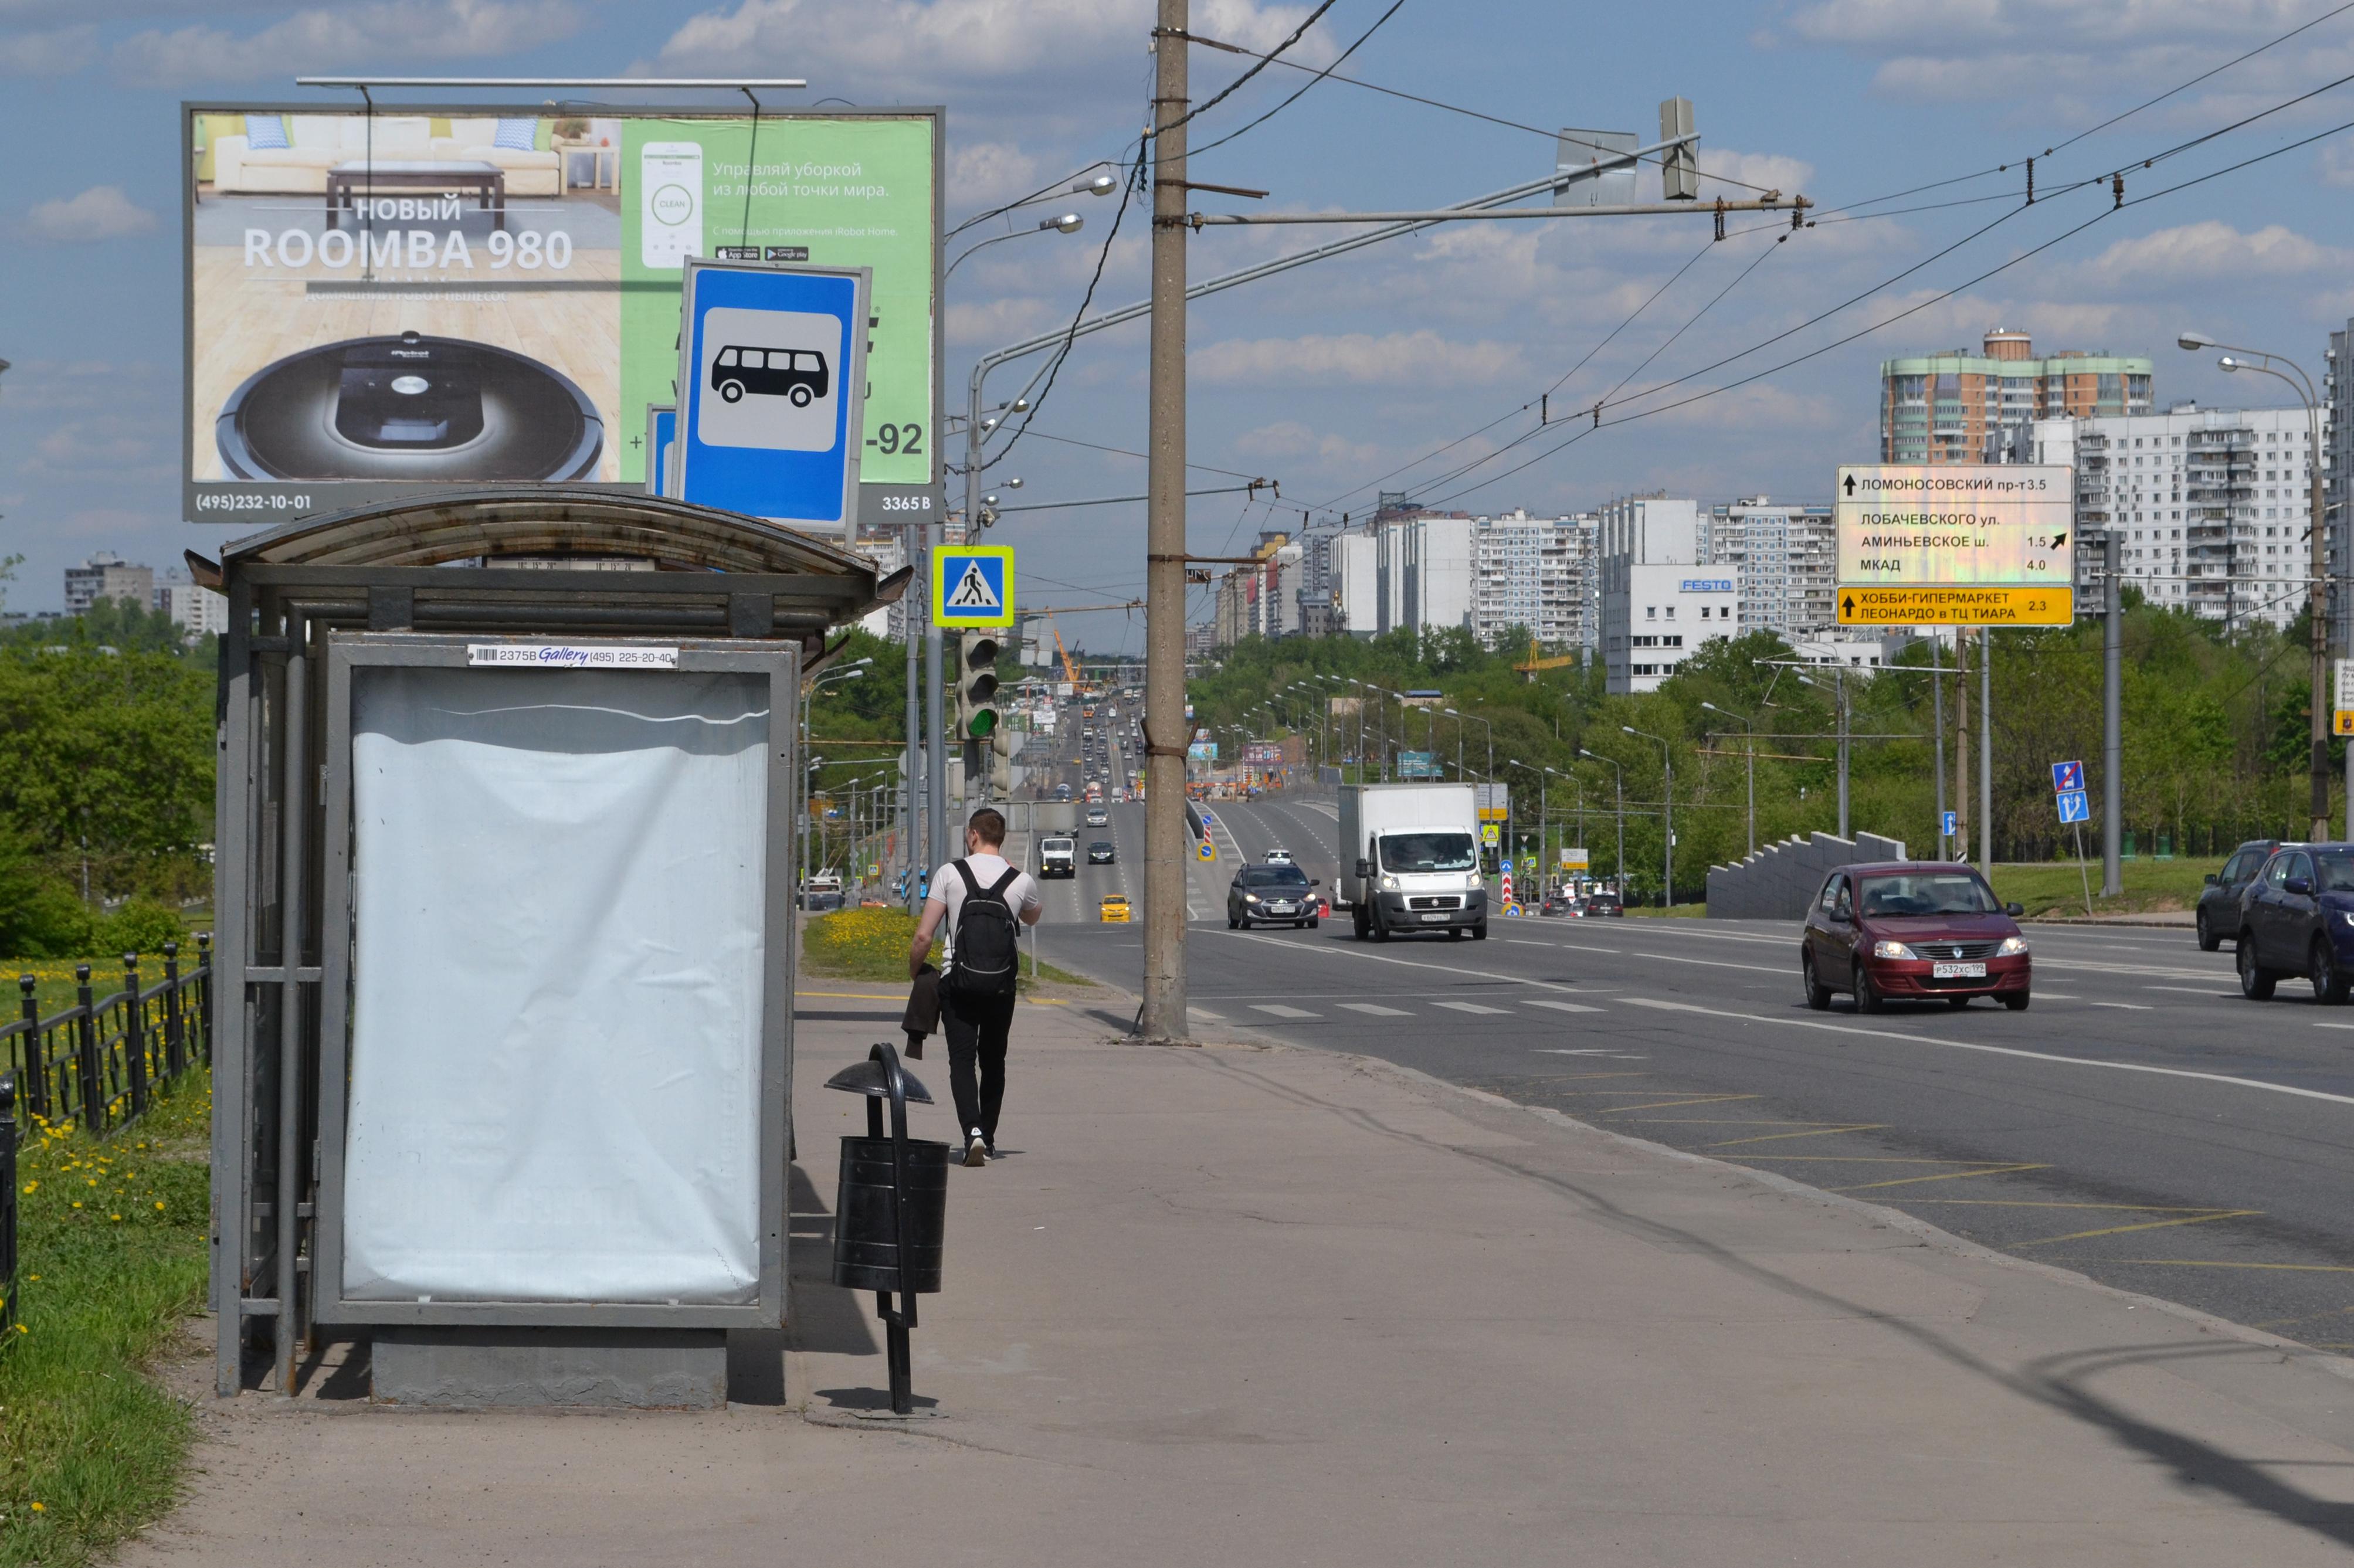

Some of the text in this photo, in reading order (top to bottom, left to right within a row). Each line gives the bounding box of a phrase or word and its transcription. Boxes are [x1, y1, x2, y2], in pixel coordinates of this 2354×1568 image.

[713, 162, 861, 180] Управляй уборкой
[713, 182, 889, 200] из любой точки мира.
[356, 193, 461, 220] НОВЫЙ
[721, 228, 769, 236] помощью
[772, 228, 833, 237] приложения
[836, 226, 865, 236] iRobot
[244, 228, 572, 269] ROOMBA 980
[1861, 477, 2046, 493] ЛОМОНОСОВСКИЙ пр-т 3.5
[196, 494, 311, 511] (495)232-10-01
[1861, 514, 2000, 528] ЛОБАЧЕВСКОГО ул.
[1861, 536, 2046, 548] АМИНЬЕВСКОЕ ш. 1.5
[1860, 559, 2046, 572] МКАД 4.0
[1683, 580, 1731, 590] FESTO
[1860, 593, 2009, 604] ХОББИ-ГИПЕРМАРКЕТ
[2029, 600, 2047, 612] 2.3
[1860, 608, 2016, 620] ЛЕОНАРДО в ТЦ ТИАРА
[500, 647, 671, 665] 2375B Gallery (495) 225-20-40
